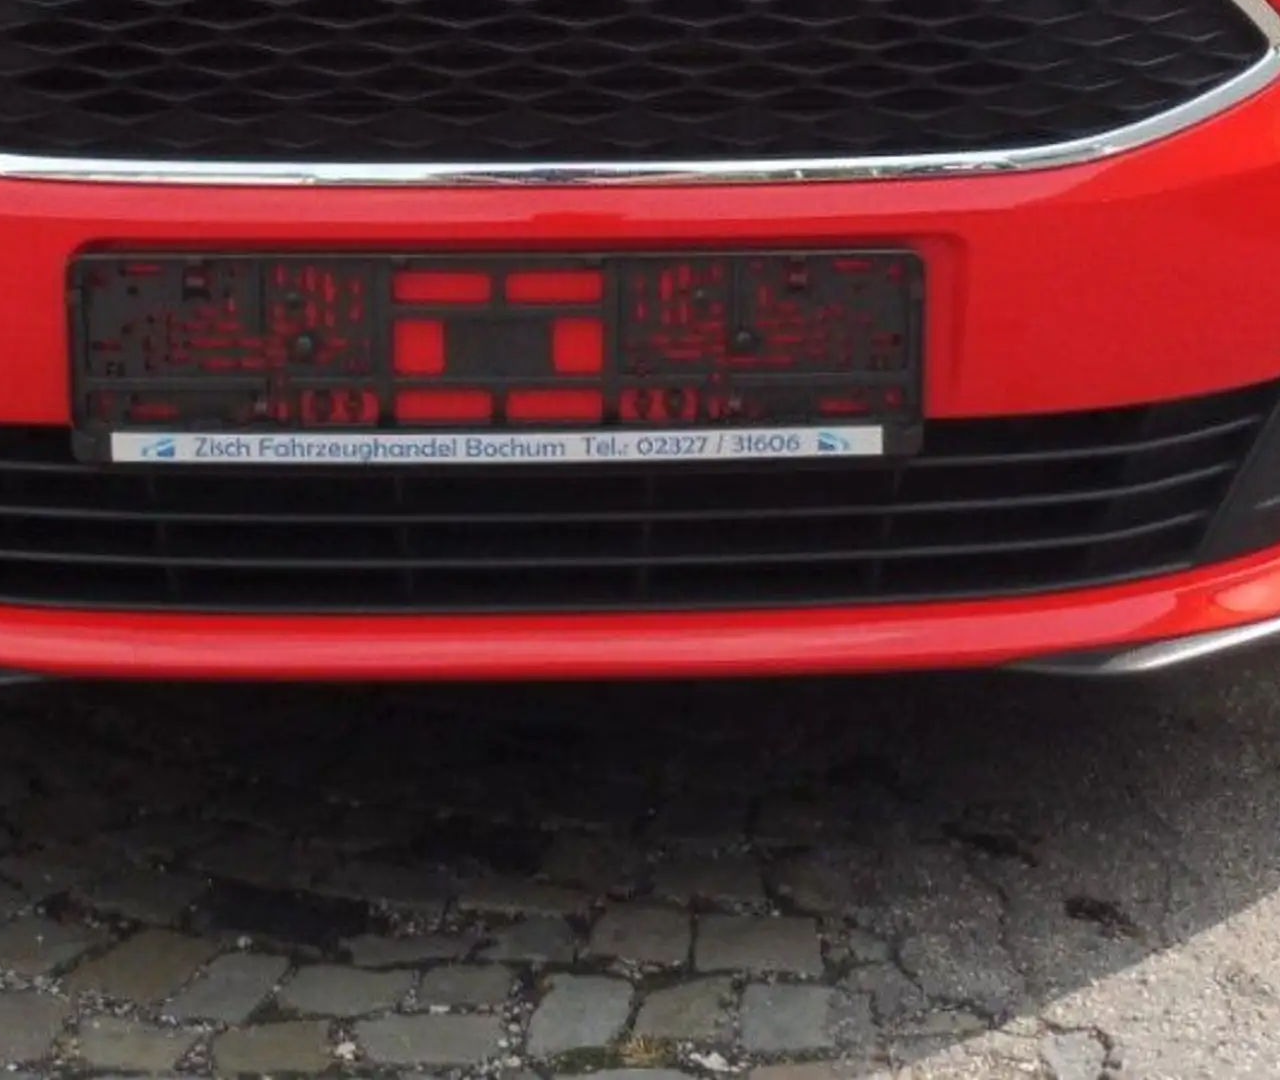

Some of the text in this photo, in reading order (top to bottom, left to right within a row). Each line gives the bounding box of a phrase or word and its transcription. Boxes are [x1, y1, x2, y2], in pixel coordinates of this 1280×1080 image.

[194, 436, 251, 458] Zisch
[258, 436, 457, 462] Fahrzeughandel
[465, 436, 566, 457] Bochum
[637, 435, 708, 455] 02327
[732, 433, 800, 453] 31606
